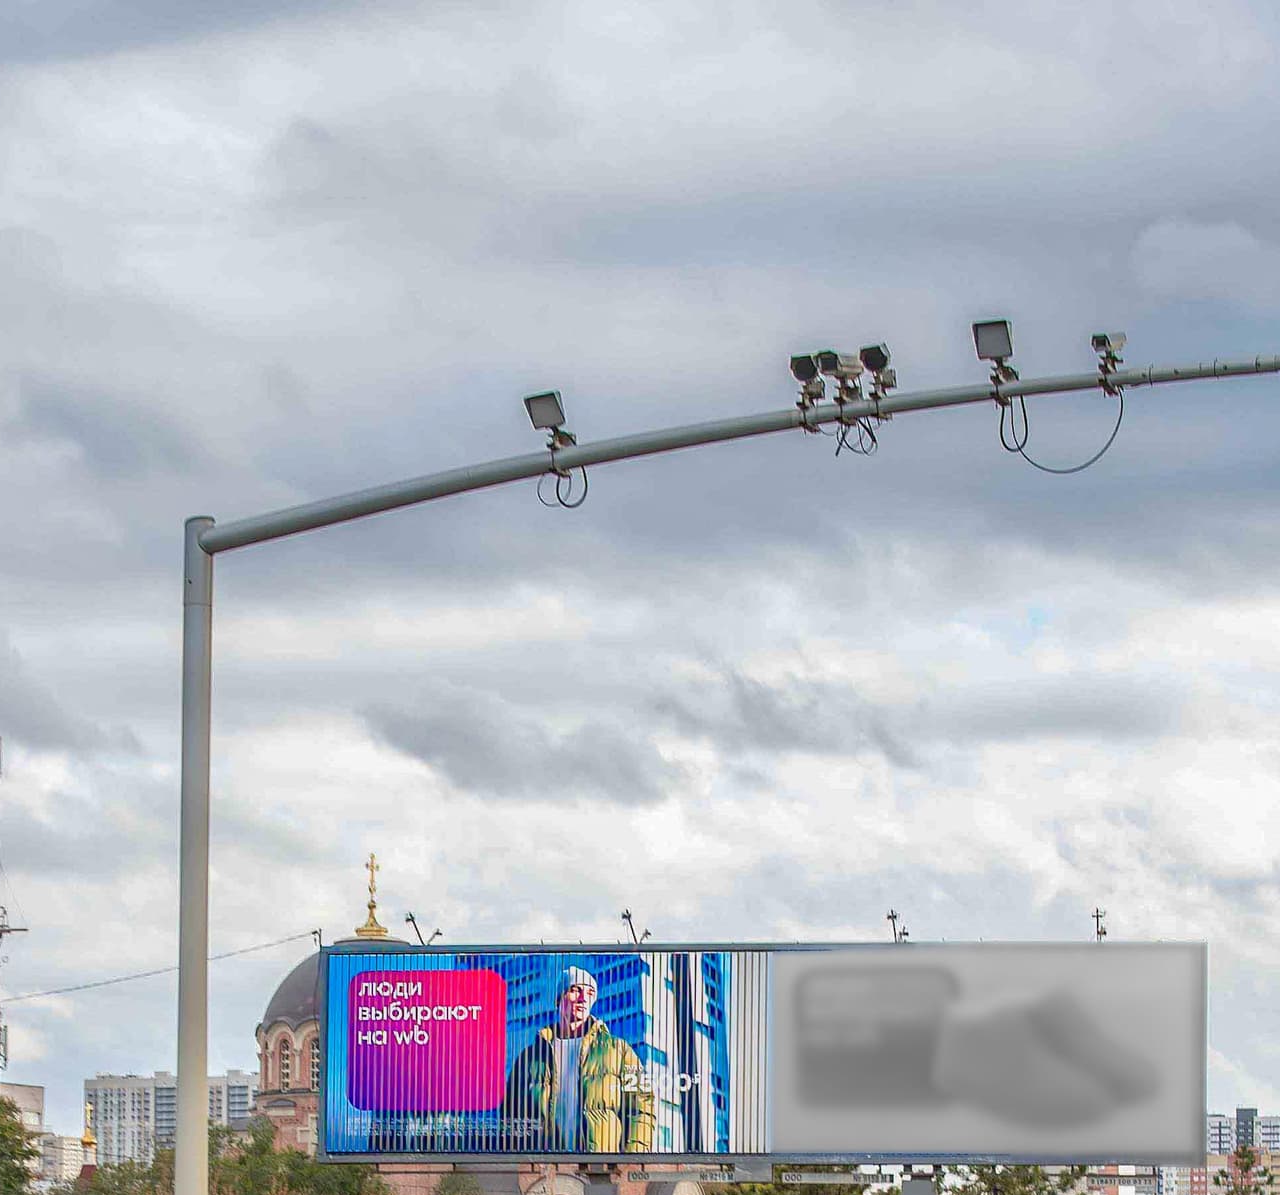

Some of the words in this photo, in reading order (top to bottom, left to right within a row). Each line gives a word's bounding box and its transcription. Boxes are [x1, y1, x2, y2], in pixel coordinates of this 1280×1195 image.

[358, 981, 422, 998] люди
[358, 1002, 482, 1025] выбирают
[358, 1030, 388, 1045] на
[394, 1025, 429, 1045] wb
